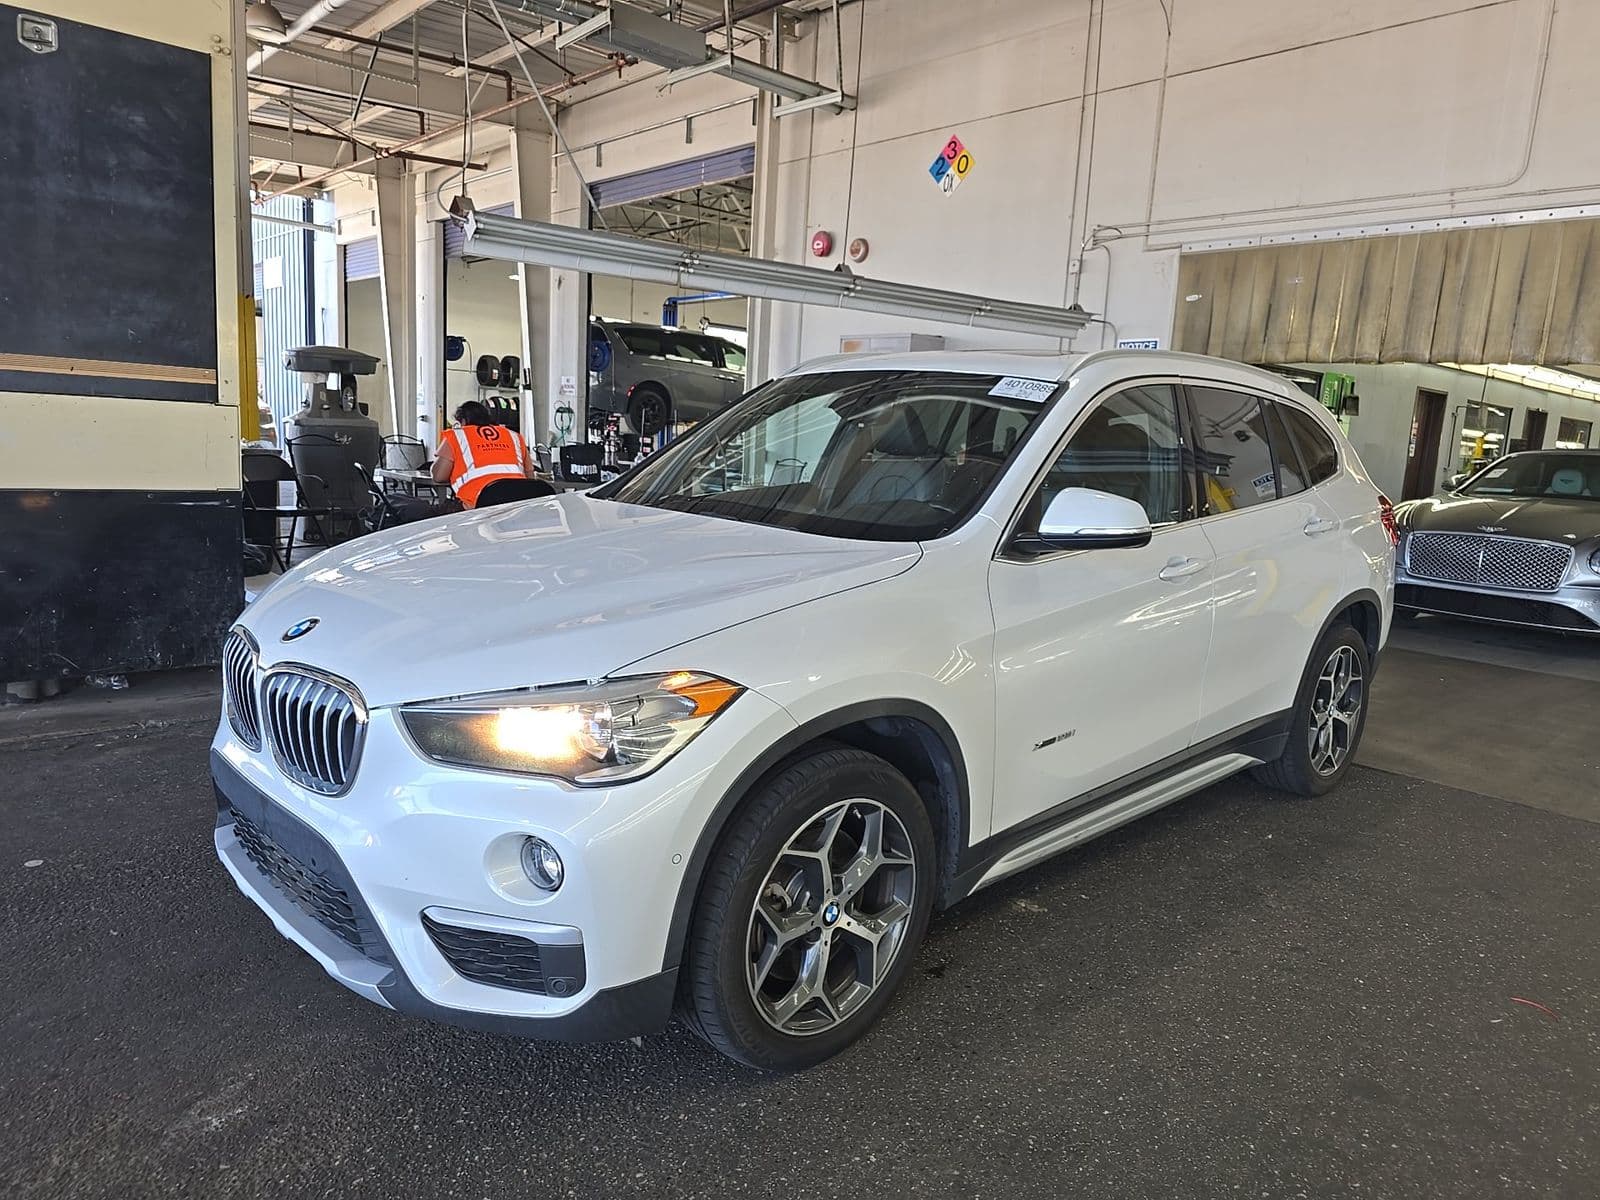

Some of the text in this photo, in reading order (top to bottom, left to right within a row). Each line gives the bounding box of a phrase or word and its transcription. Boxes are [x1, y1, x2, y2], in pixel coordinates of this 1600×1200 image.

[947, 140, 958, 160] 3
[935, 155, 946, 177] 2
[957, 154, 969, 174] 0
[1119, 341, 1157, 350] NOTICE
[1004, 379, 1056, 394] 4010889
[570, 463, 598, 475] PUMA
